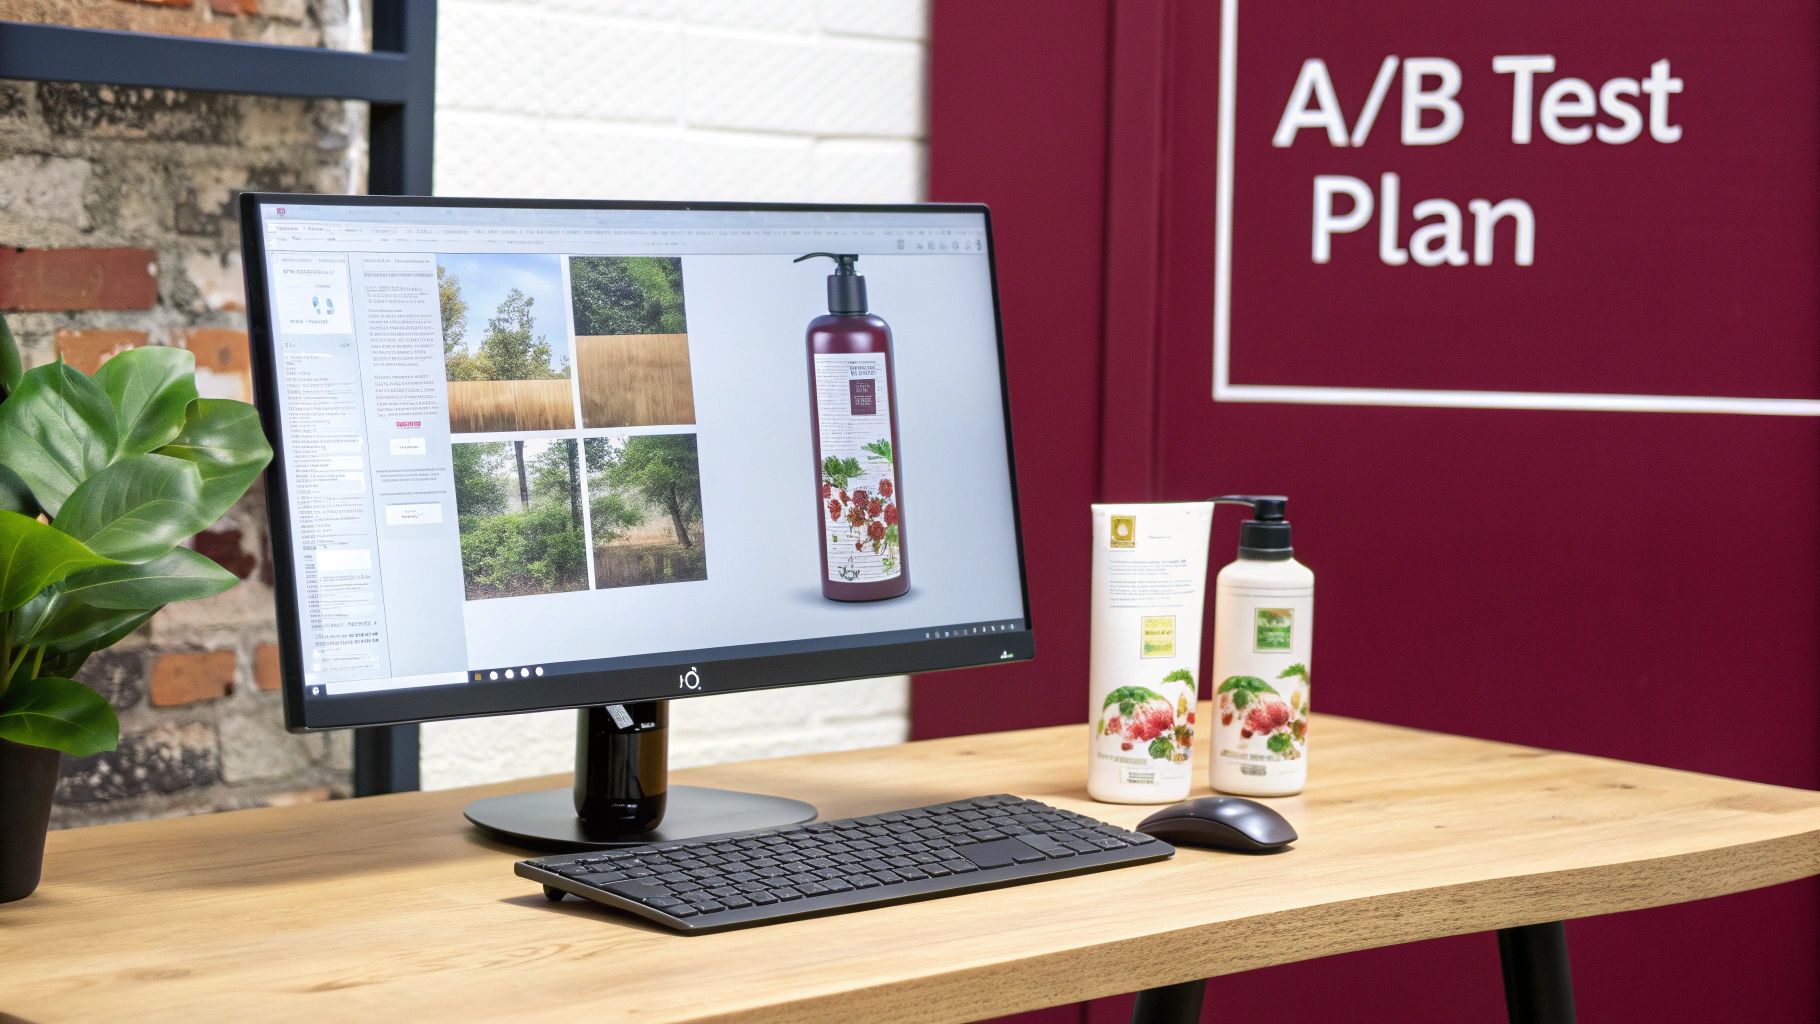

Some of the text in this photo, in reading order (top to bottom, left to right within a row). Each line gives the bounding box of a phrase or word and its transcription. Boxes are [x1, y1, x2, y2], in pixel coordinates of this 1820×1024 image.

[1273, 55, 1683, 147] A/B Test
[1312, 173, 1534, 266] Plan
